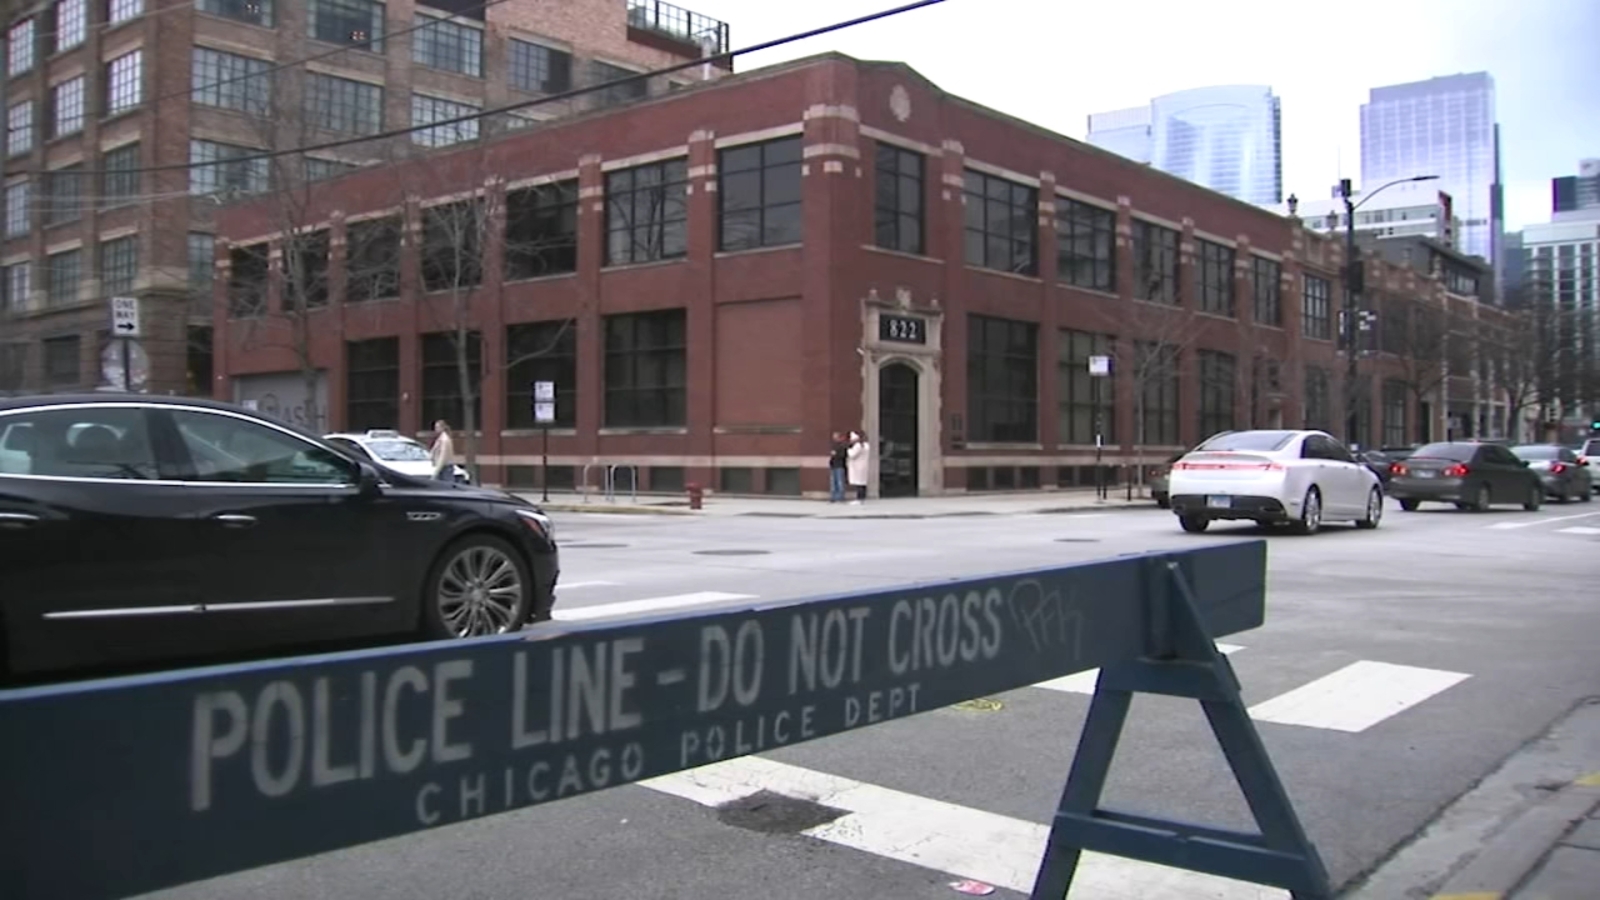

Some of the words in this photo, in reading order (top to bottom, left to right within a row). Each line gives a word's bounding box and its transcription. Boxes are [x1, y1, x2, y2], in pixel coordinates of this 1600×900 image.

[115, 300, 135, 310] ONE
[115, 311, 135, 319] WAY
[890, 319, 916, 338] 822
[191, 659, 474, 812] POLICE
[511, 637, 645, 750] LINE
[697, 619, 765, 713] DO
[788, 606, 871, 696] NOT
[888, 587, 1003, 677] CROSS
[416, 742, 643, 825] CHICAGO
[680, 705, 816, 768] POLICE
[844, 683, 921, 728] DEPT
